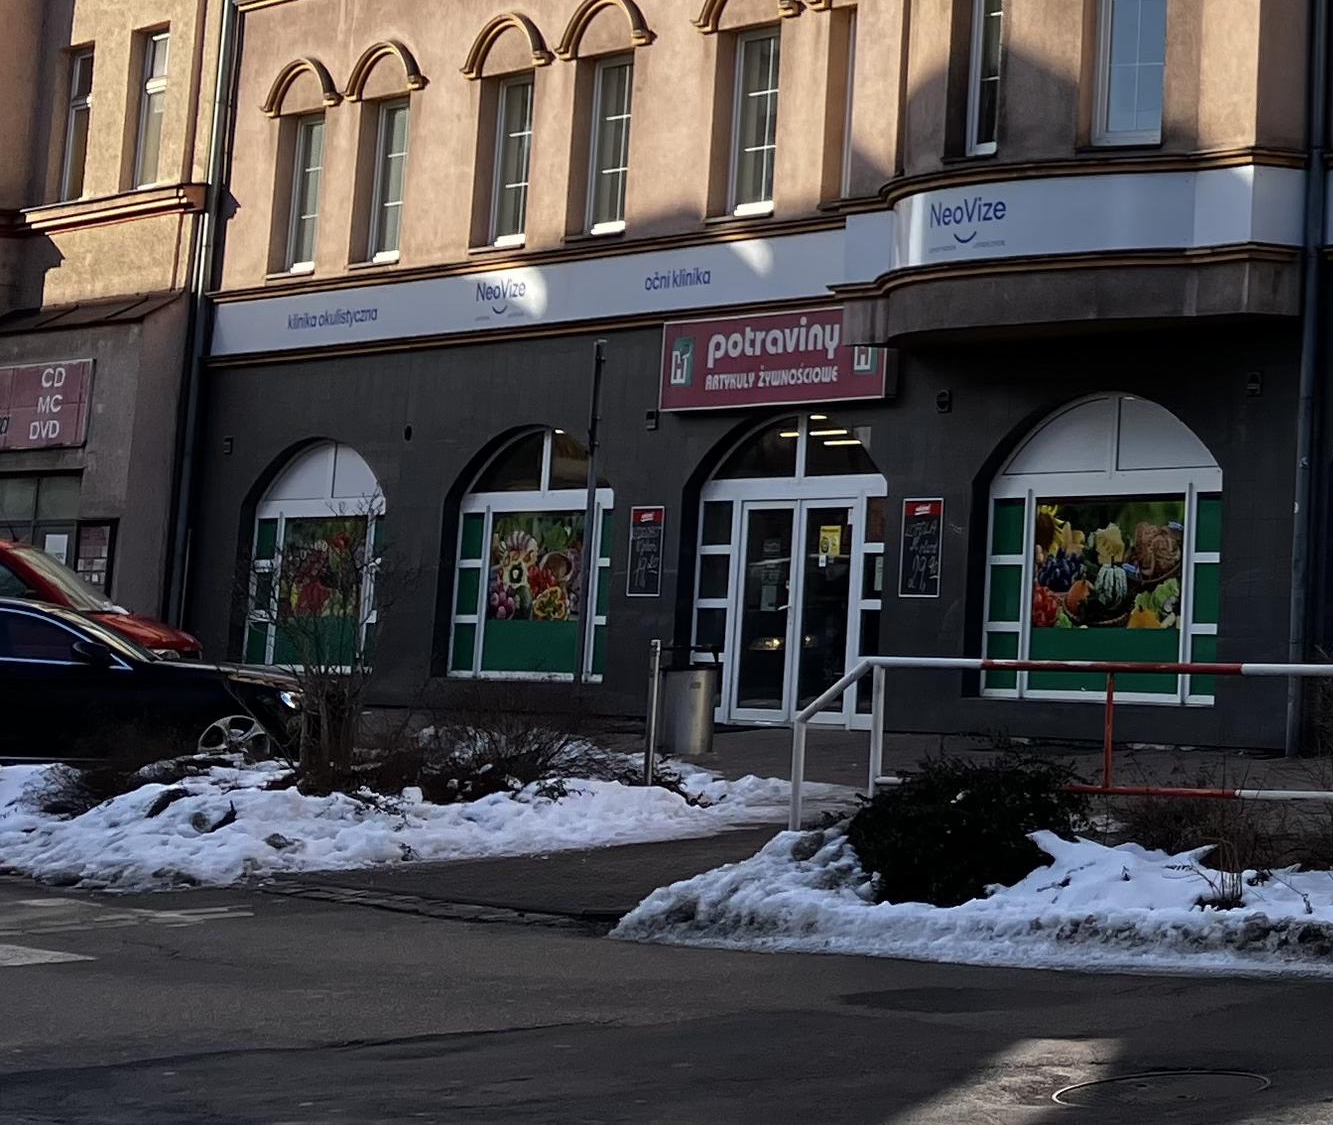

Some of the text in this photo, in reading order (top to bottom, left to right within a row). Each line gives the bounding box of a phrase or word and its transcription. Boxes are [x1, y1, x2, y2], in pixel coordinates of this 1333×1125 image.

[930, 196, 1007, 229] NeoVize
[672, 266, 712, 288] klinika
[475, 278, 527, 302] NeoVize
[287, 307, 378, 330] klinika okulistyczna
[706, 315, 841, 369] potraviny
[41, 367, 66, 388] CD
[37, 394, 63, 414] MC
[29, 420, 60, 440] DVD
